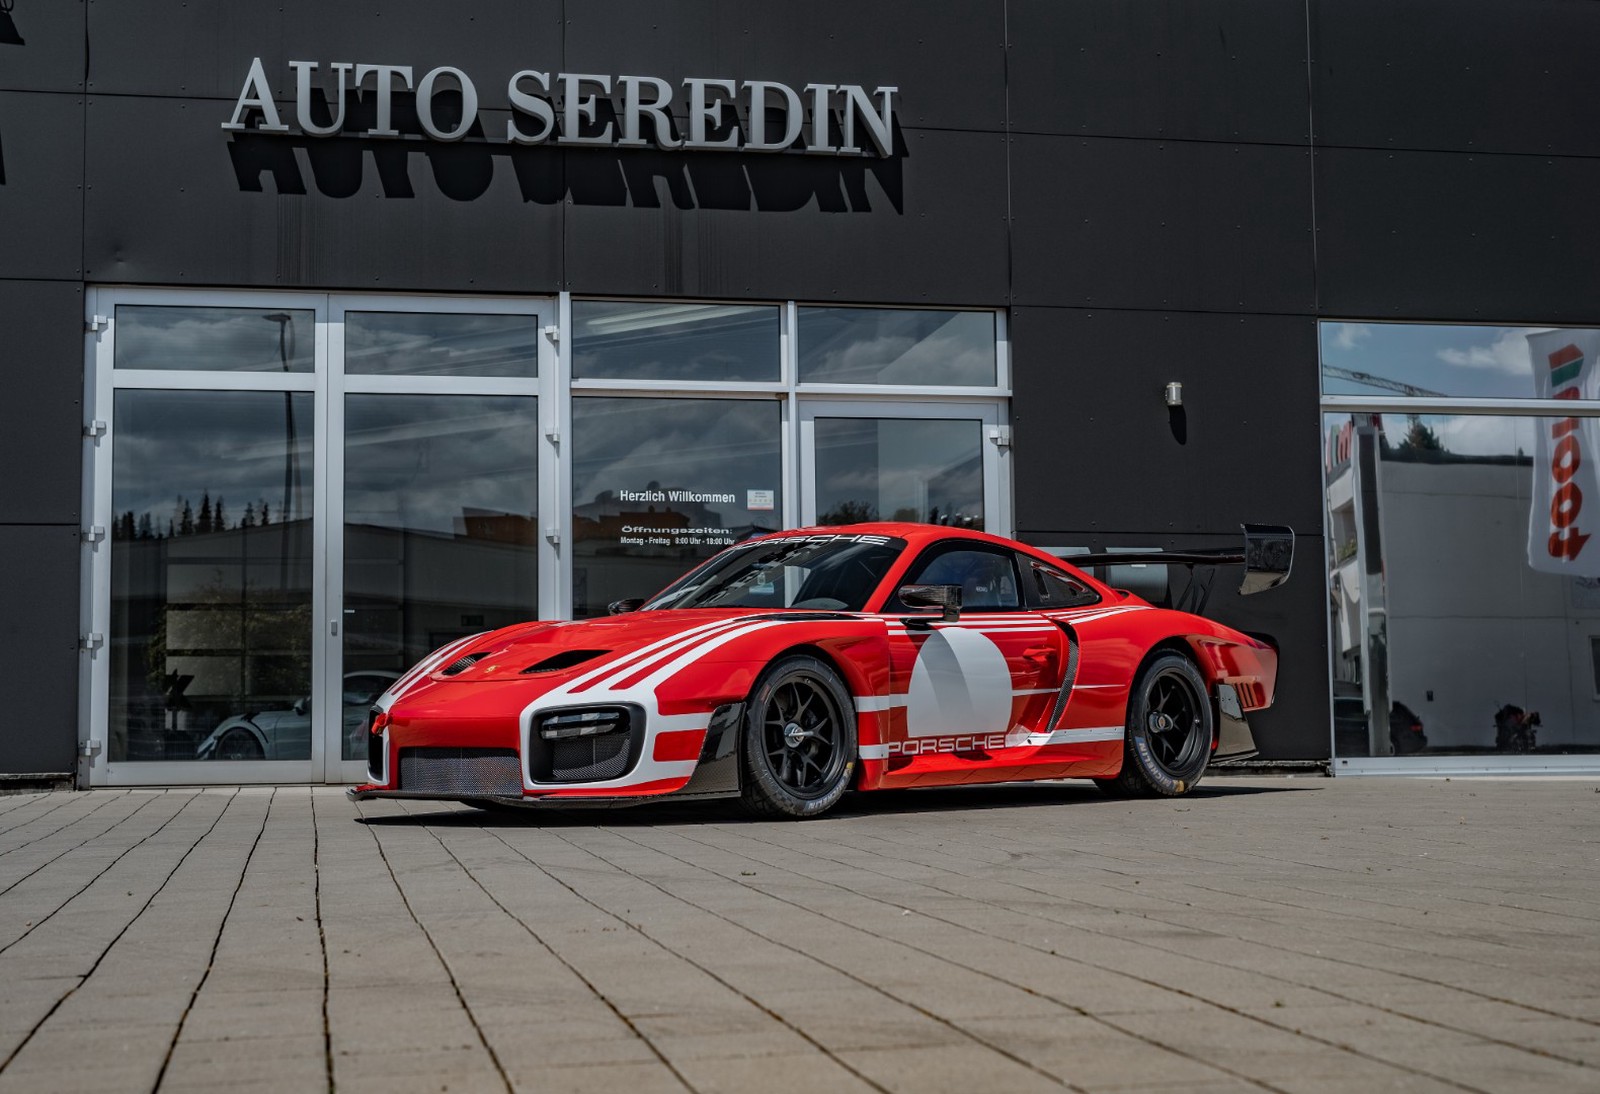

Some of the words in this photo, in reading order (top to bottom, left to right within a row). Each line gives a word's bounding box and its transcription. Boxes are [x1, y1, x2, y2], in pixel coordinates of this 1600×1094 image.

[221, 57, 478, 142] AUTO
[507, 70, 898, 158] SEREDIN
[620, 490, 665, 502] Herzlich
[668, 490, 736, 503] Willkommen
[621, 525, 733, 535] Öffnungszeiten:
[620, 536, 643, 546] Montag
[649, 537, 670, 546] Freitag
[675, 537, 689, 545] 8:00
[690, 537, 701, 545] Uhr
[706, 537, 723, 545] 18:00
[724, 537, 735, 545] Uhr
[888, 734, 1005, 755] PORSCHE
[1138, 742, 1173, 788] MICHELIN
